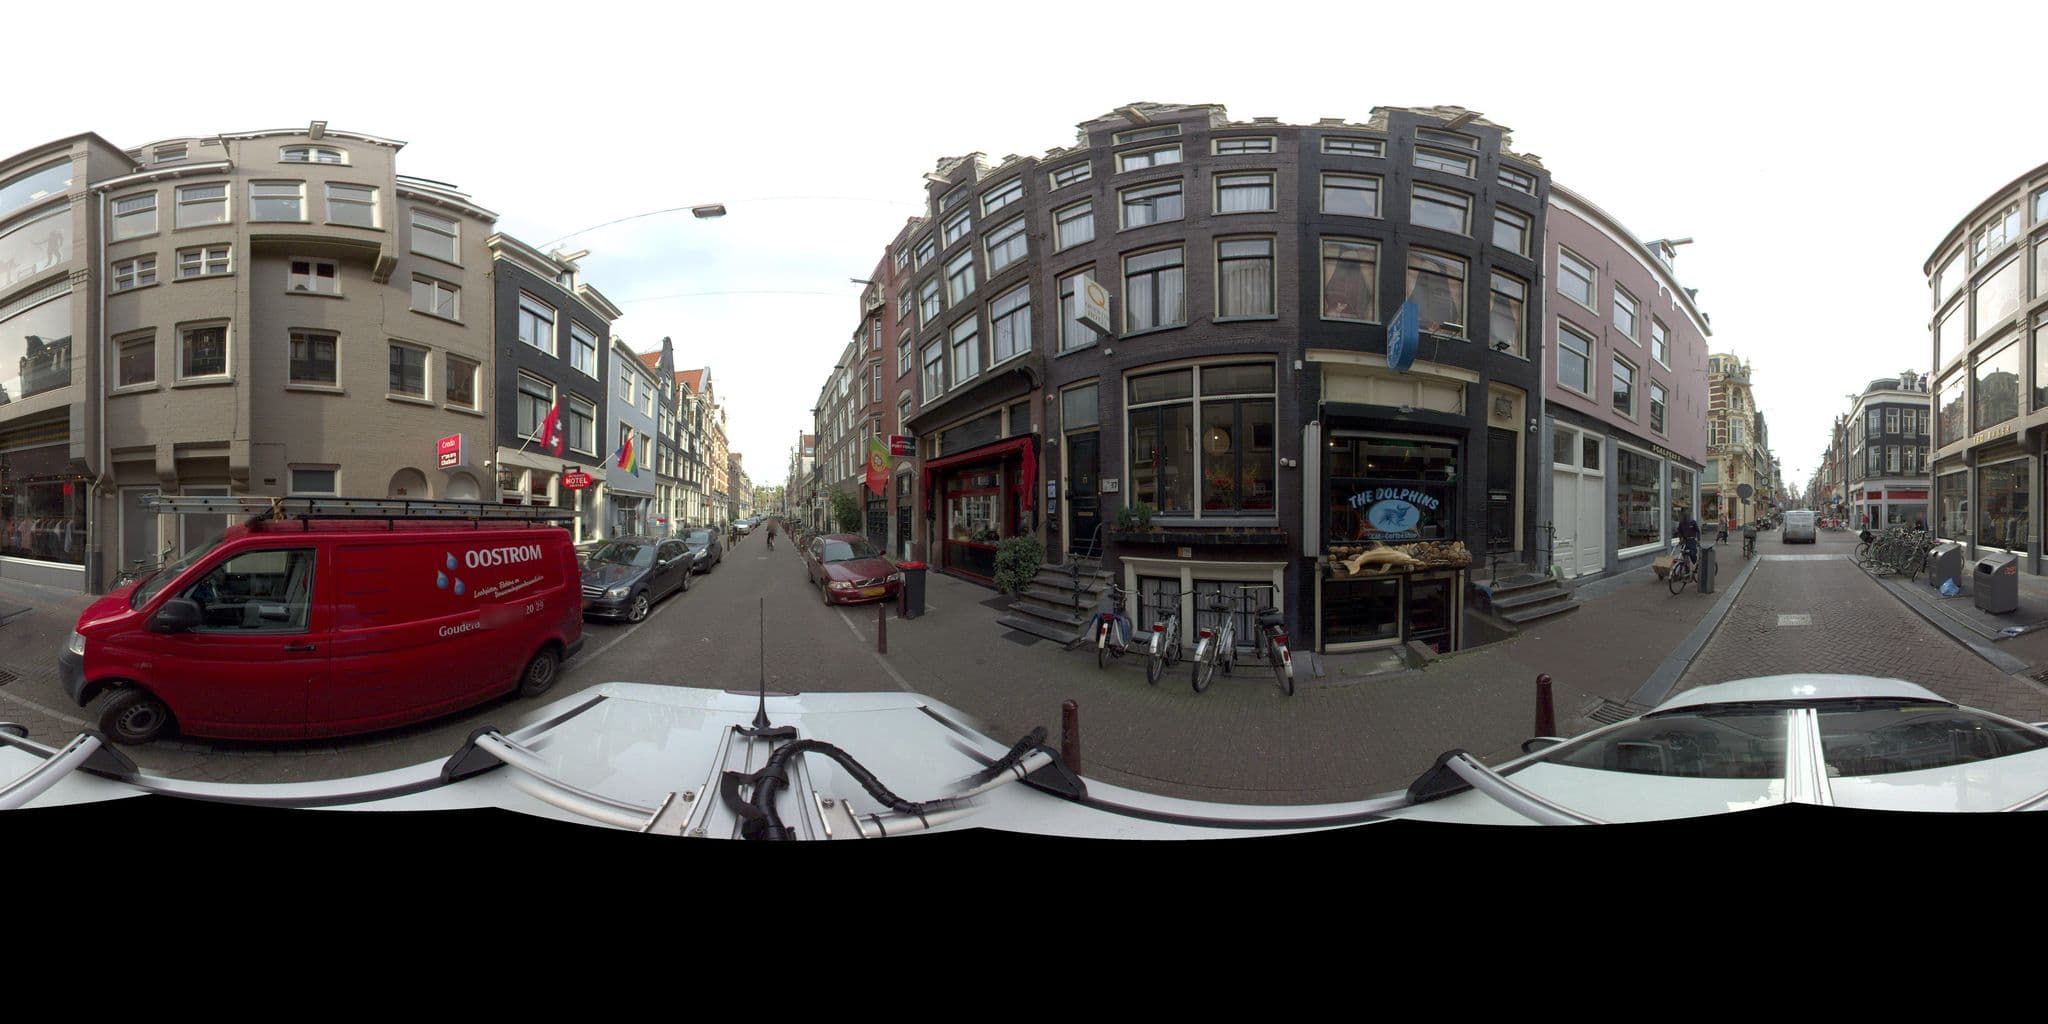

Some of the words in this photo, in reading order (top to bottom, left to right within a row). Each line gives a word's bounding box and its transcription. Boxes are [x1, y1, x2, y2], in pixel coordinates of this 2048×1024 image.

[1348, 490, 1374, 509] THE
[1375, 487, 1440, 510] DOLPHINS
[465, 544, 543, 569] OOSTROM
